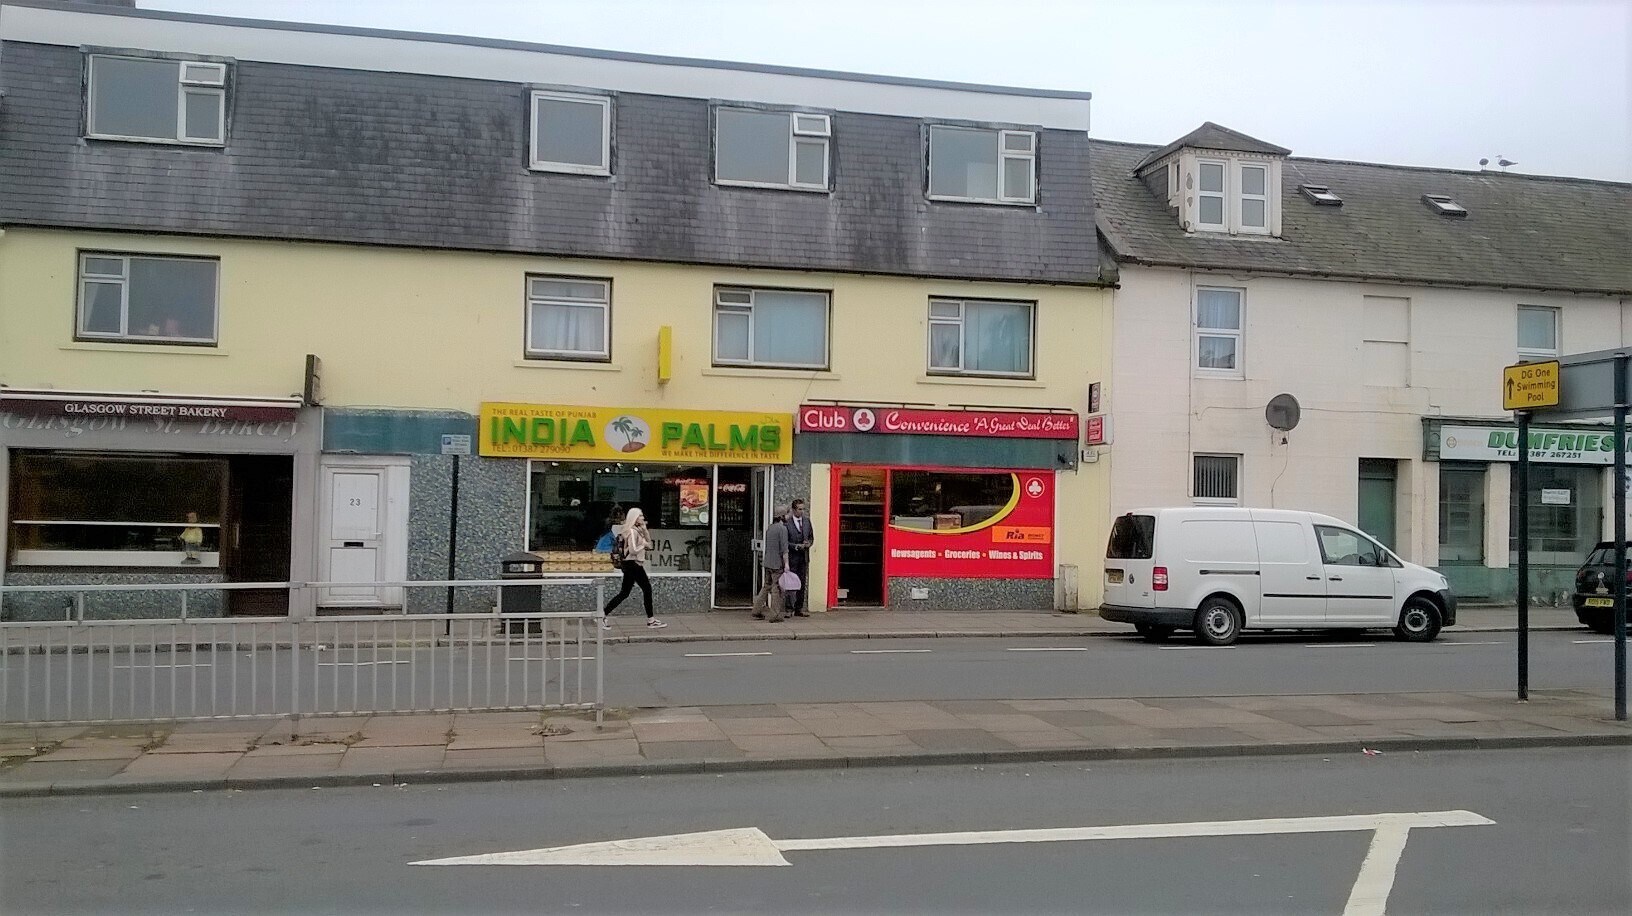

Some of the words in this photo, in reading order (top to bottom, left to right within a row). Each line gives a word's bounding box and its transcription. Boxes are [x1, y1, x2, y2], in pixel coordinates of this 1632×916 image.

[1521, 369, 1533, 379] DG
[1535, 368, 1551, 378] One
[1516, 378, 1556, 392] Swimming
[1527, 391, 1545, 402] Pool
[64, 403, 126, 414] GLASGOW
[129, 404, 177, 416] STREET
[178, 407, 228, 418] BAKERY
[492, 408, 506, 416] THE
[530, 409, 552, 417] TASTE
[555, 410, 565, 418] OF
[804, 410, 846, 428] Club
[886, 411, 970, 432] Convenience
[988, 416, 1015, 434] Great
[491, 416, 596, 446] INDIA
[661, 422, 781, 452] PALMS
[709, 451, 749, 459] DIFFERENCE
[1550, 451, 1581, 459] 267251
[349, 498, 361, 507] 23
[1005, 528, 1025, 540] Ria
[891, 549, 936, 560] Newsagents
[944, 549, 981, 560] Groceries
[988, 550, 1012, 560] Wines
[1012, 551, 1018, 560] &
[1018, 550, 1044, 561] Spirits
